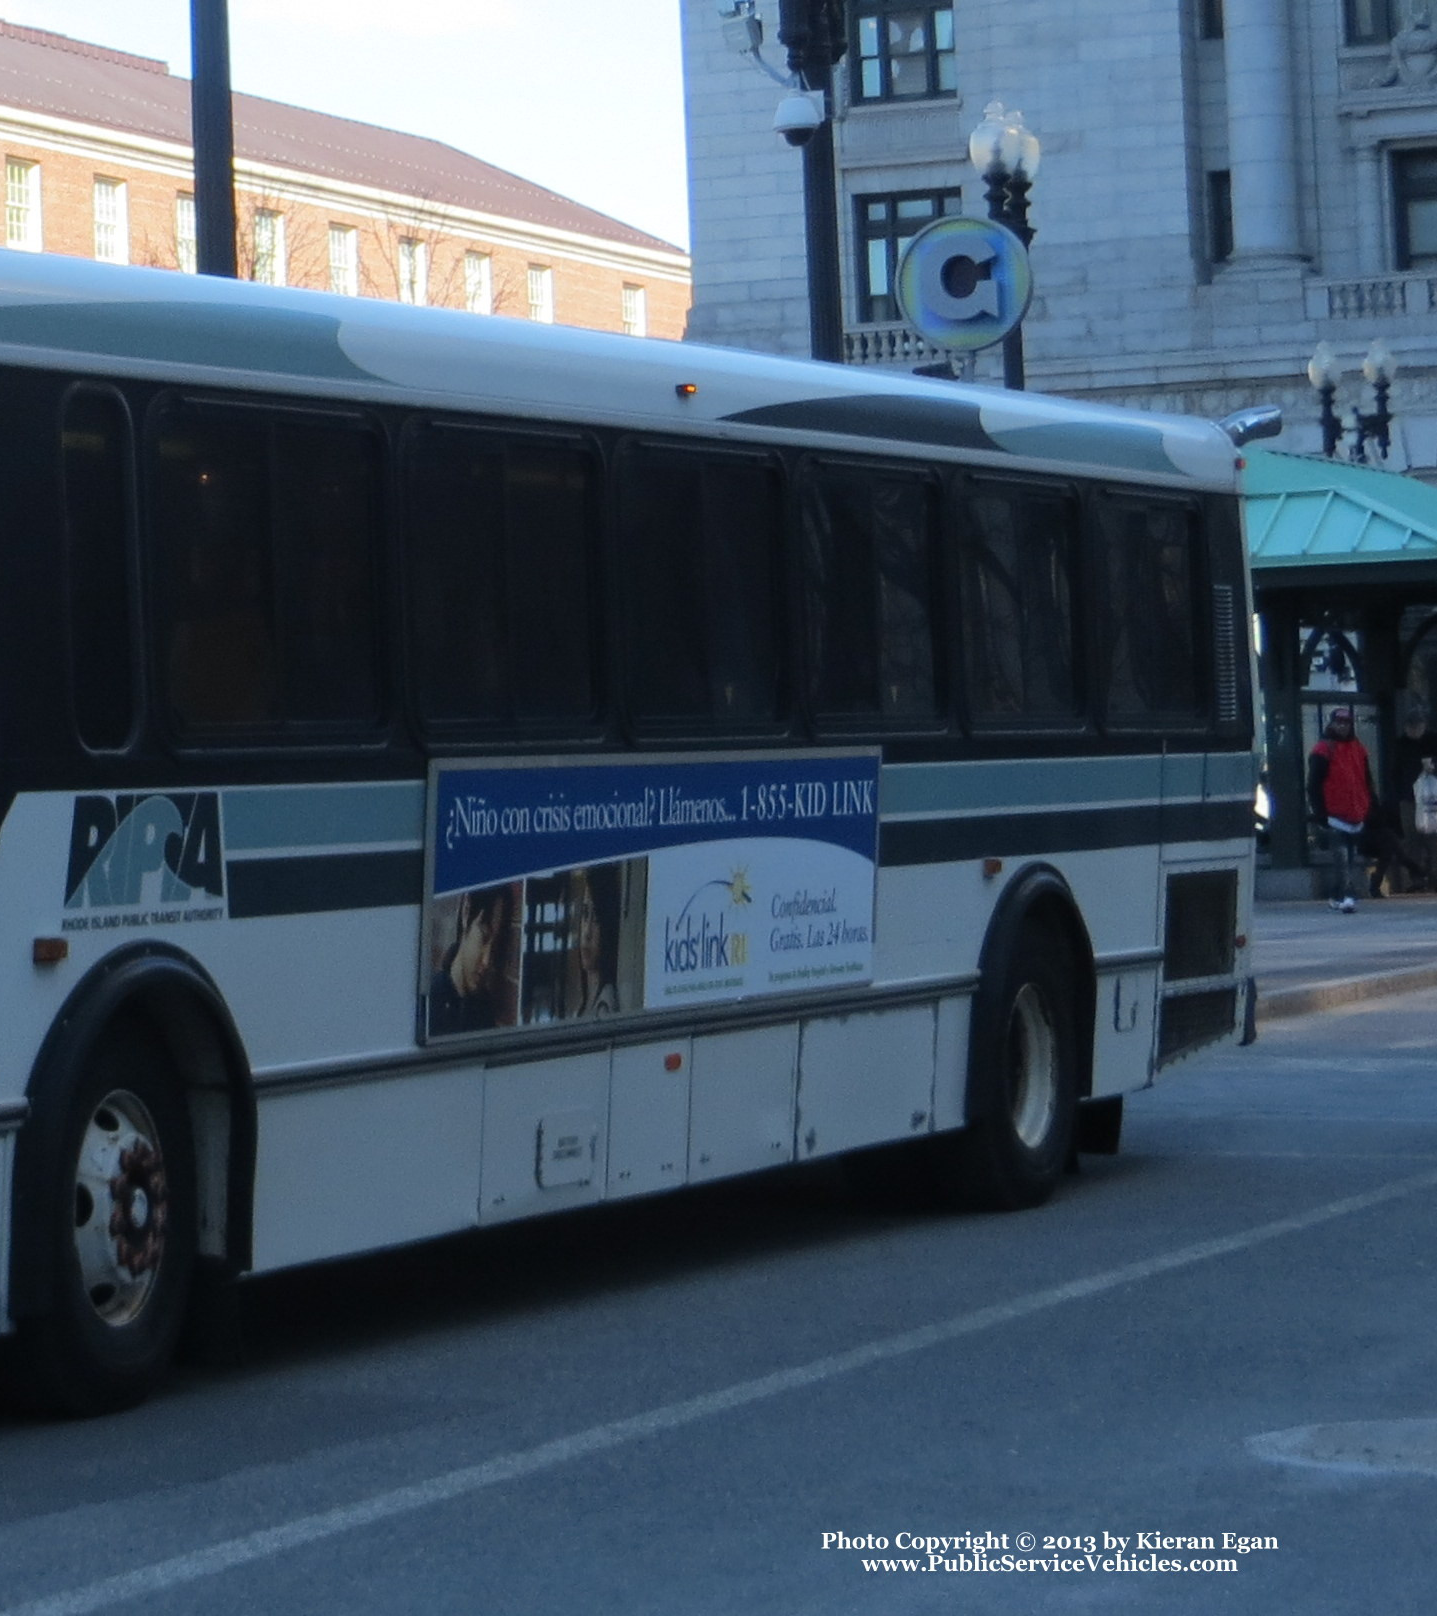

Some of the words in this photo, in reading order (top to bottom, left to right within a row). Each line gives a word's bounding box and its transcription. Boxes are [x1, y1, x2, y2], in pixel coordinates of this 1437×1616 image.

[446, 796, 498, 849] ¿Niño
[501, 806, 530, 835] con
[533, 793, 571, 833] crisis
[573, 787, 656, 830] emocional?
[741, 781, 827, 821] 1-855-KID
[832, 779, 874, 816] LINK
[65, 792, 224, 909] RIPTA
[61, 916, 89, 931] RHODE
[91, 914, 120, 930] ISLAND
[122, 912, 149, 927] PUBLIC
[151, 910, 181, 925] TRANSIT
[183, 907, 224, 923] AUTHORITY
